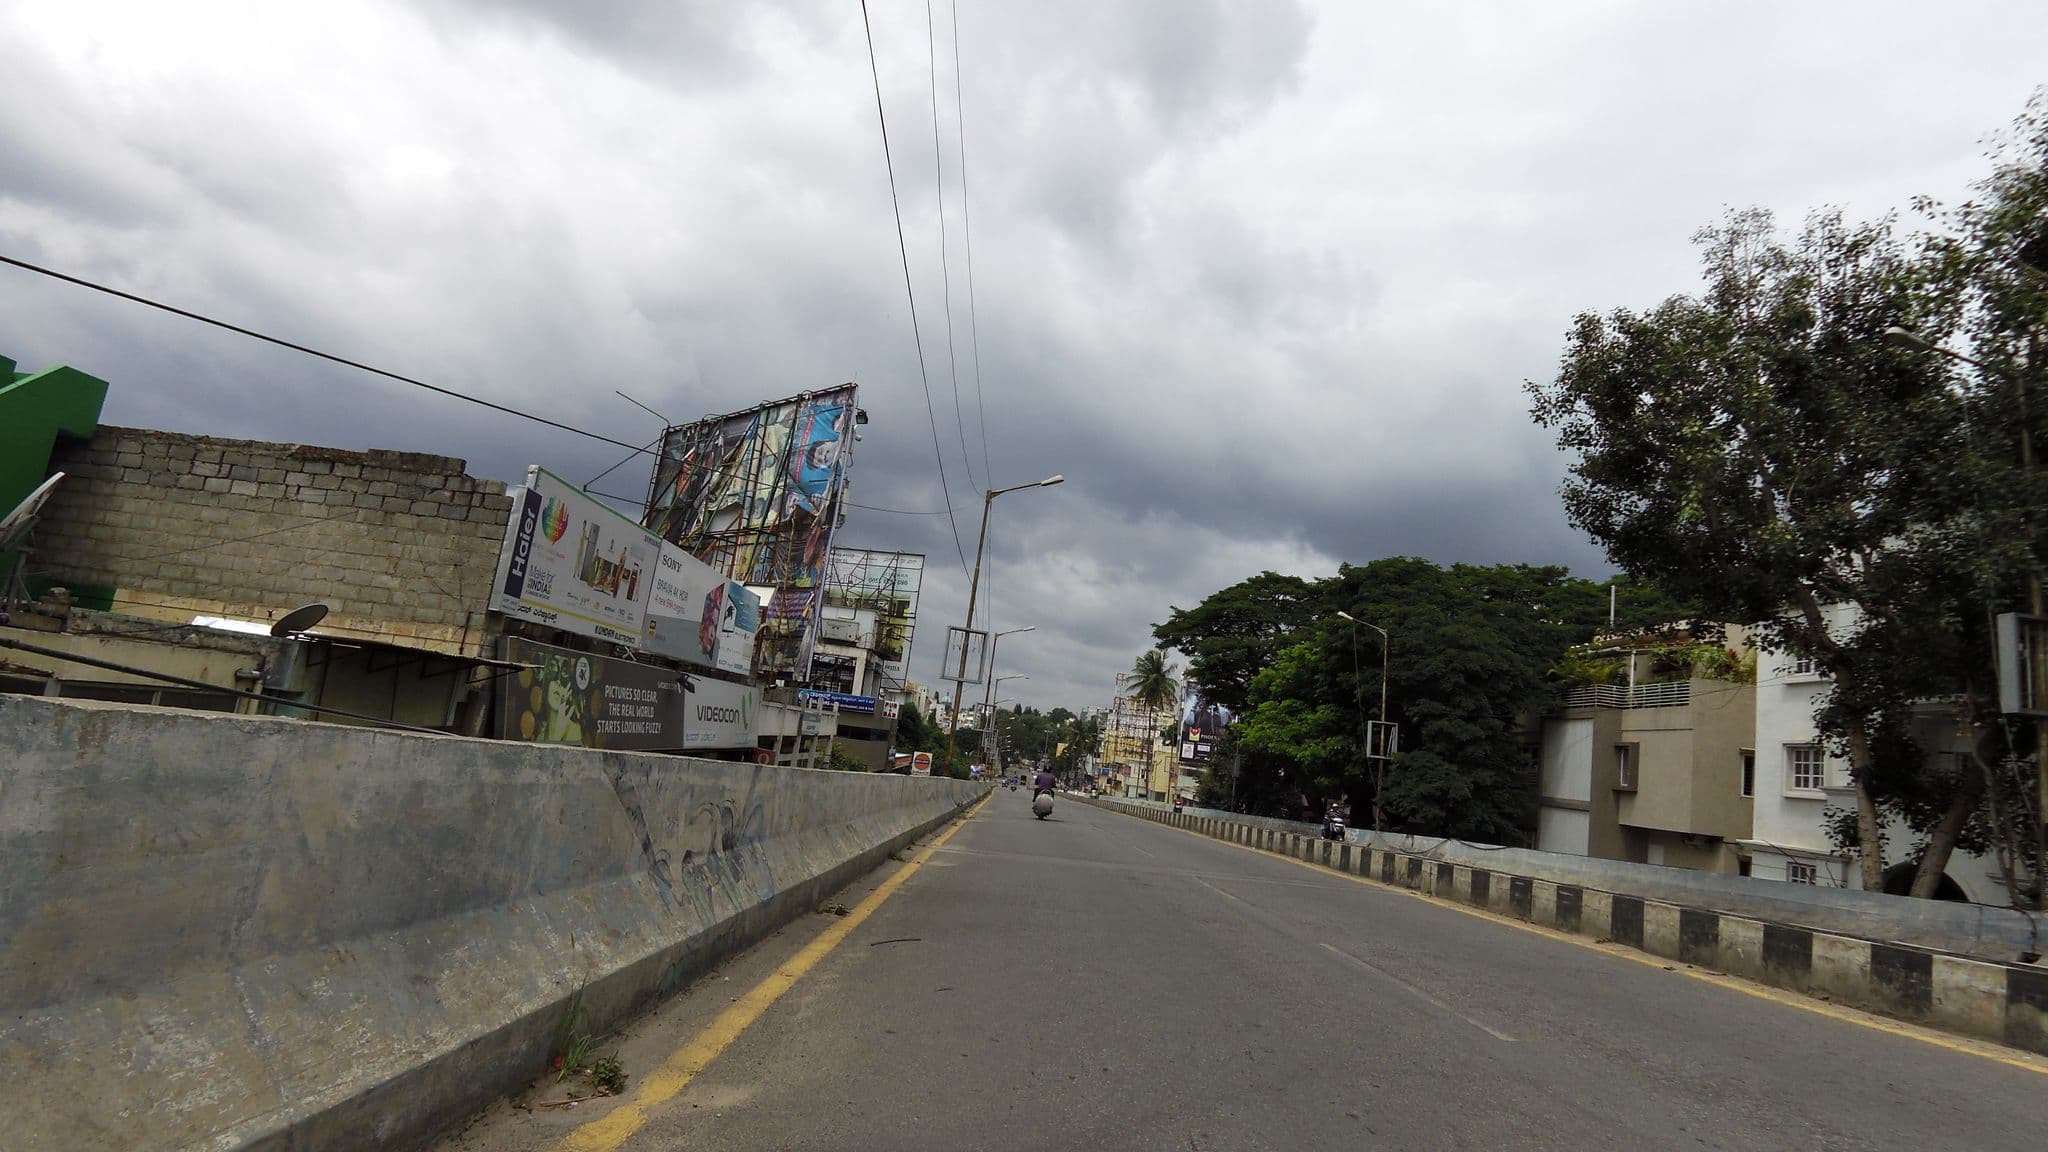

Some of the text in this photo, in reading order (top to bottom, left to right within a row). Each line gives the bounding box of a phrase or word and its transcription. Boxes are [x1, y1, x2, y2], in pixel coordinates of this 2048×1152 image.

[512, 507, 535, 577] Haier
[662, 554, 682, 573] SONY
[531, 578, 548, 593] INDIA
[604, 685, 632, 701] PICTURES
[633, 688, 641, 701] SO
[609, 703, 655, 719] THE REAL WORLD
[697, 704, 740, 724] VIDEOCON
[597, 719, 621, 734] STARTS
[621, 721, 645, 734] LOOKING
